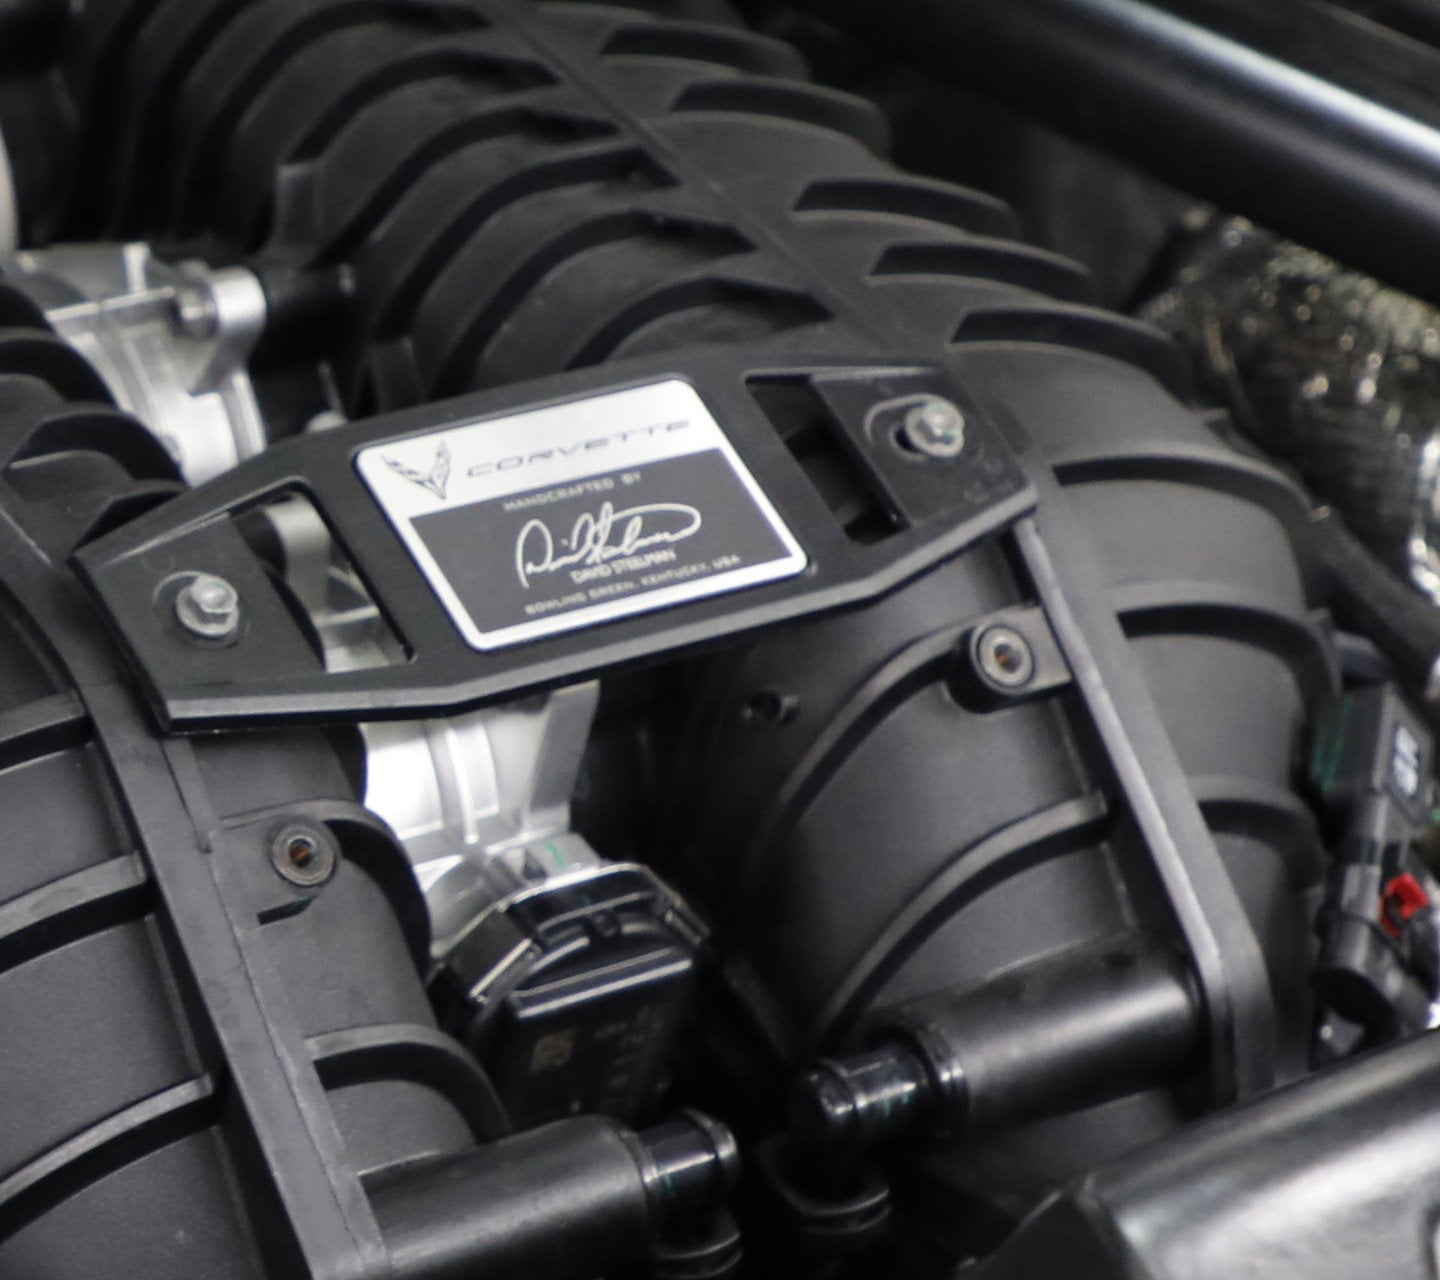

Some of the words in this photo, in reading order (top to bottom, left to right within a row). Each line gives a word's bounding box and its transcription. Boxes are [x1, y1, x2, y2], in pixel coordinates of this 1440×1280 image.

[467, 420, 689, 476] CORVETTE
[503, 477, 615, 510] HANDCRAFTED
[620, 471, 642, 486] BY
[524, 591, 588, 616] BOWLING
